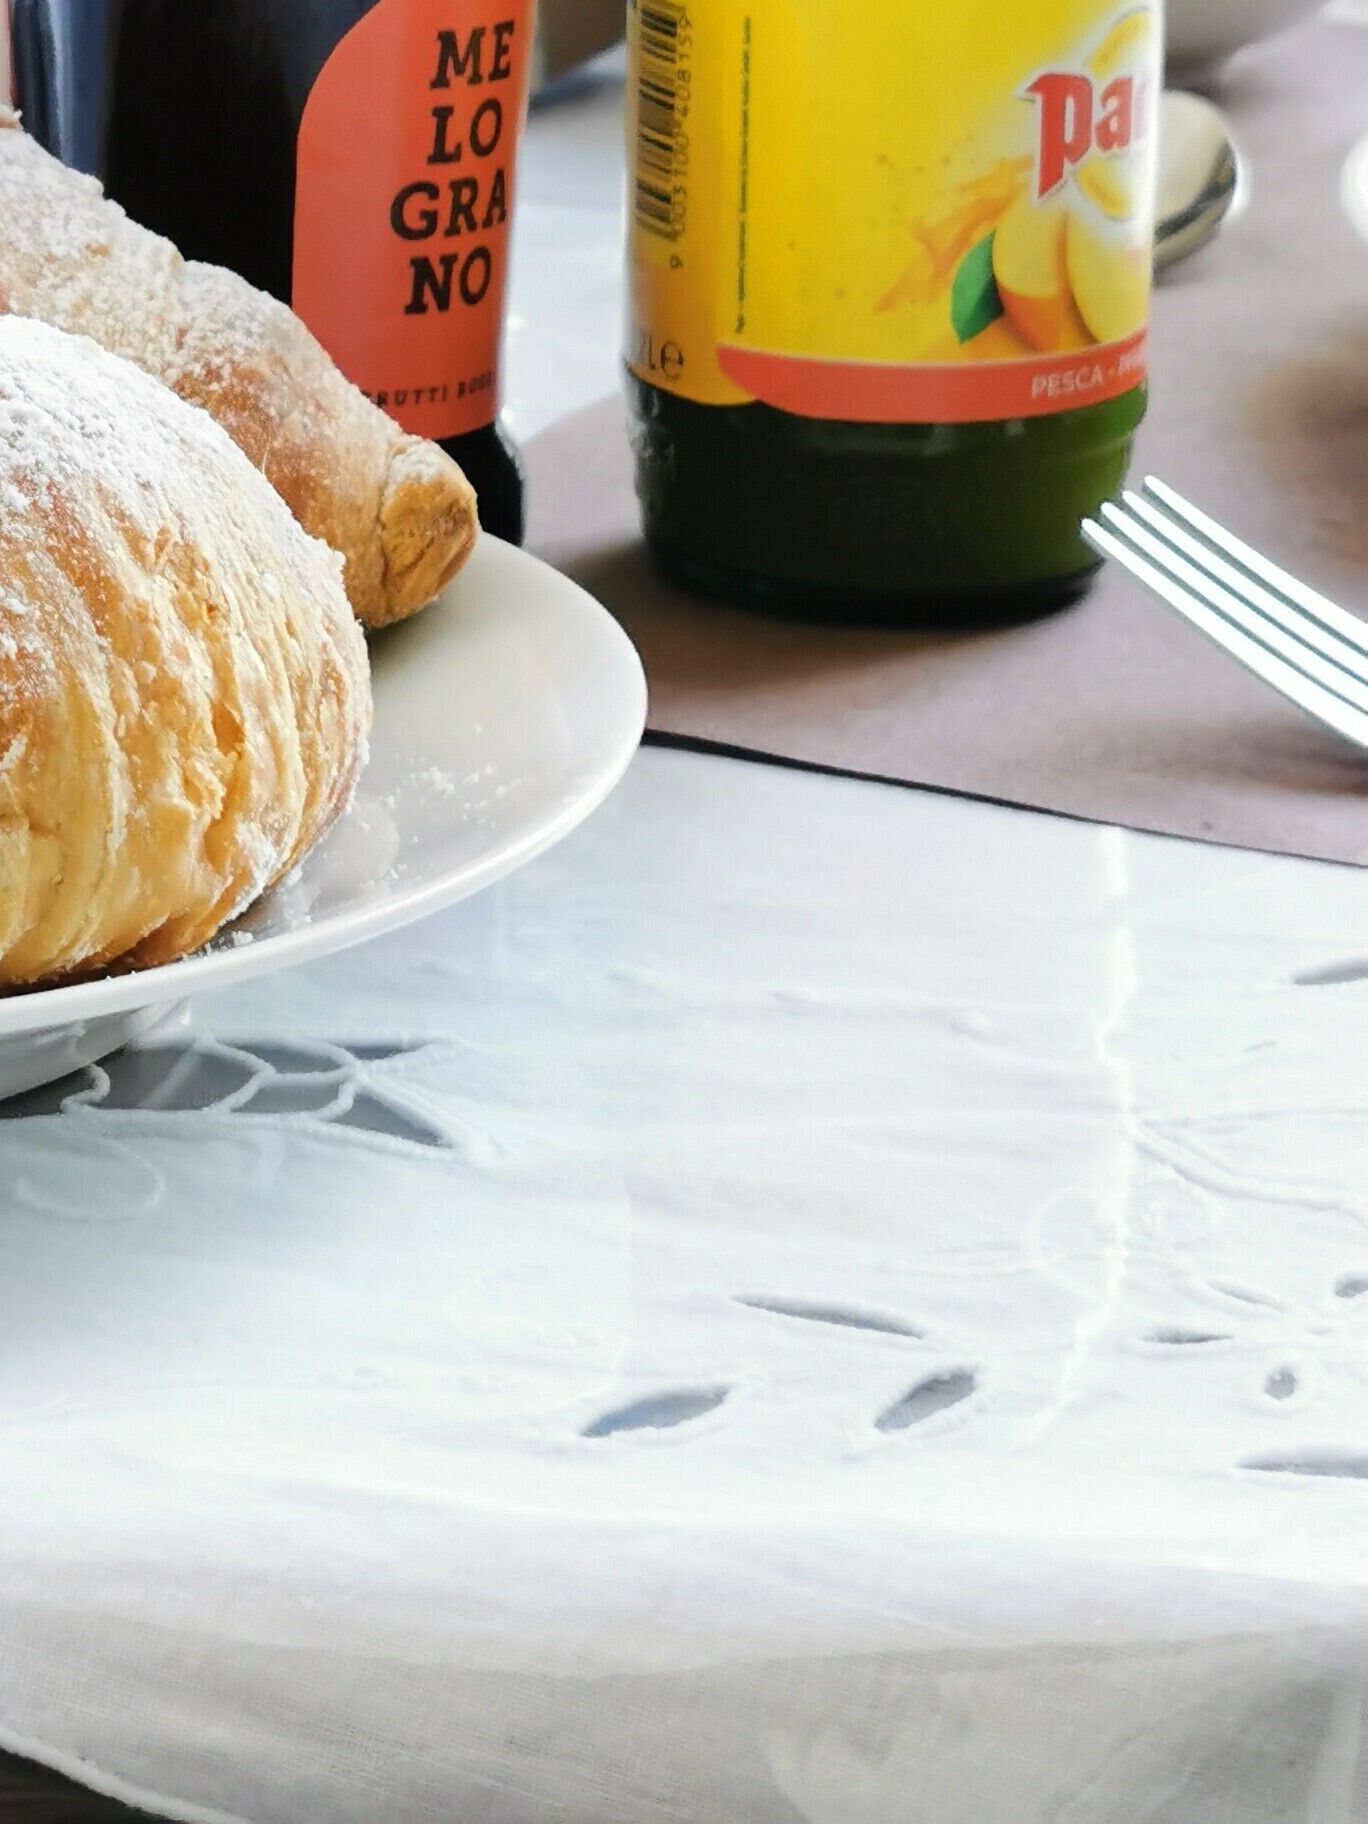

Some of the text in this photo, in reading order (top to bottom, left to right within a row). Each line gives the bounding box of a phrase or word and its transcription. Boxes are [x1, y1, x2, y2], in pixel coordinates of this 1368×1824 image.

[430, 20, 515, 88] ME
[427, 97, 502, 165] LO
[390, 169, 507, 241] GRA
[404, 247, 492, 315] NO
[361, 382, 448, 408] RUTTI
[1031, 365, 1104, 398] PESCA
